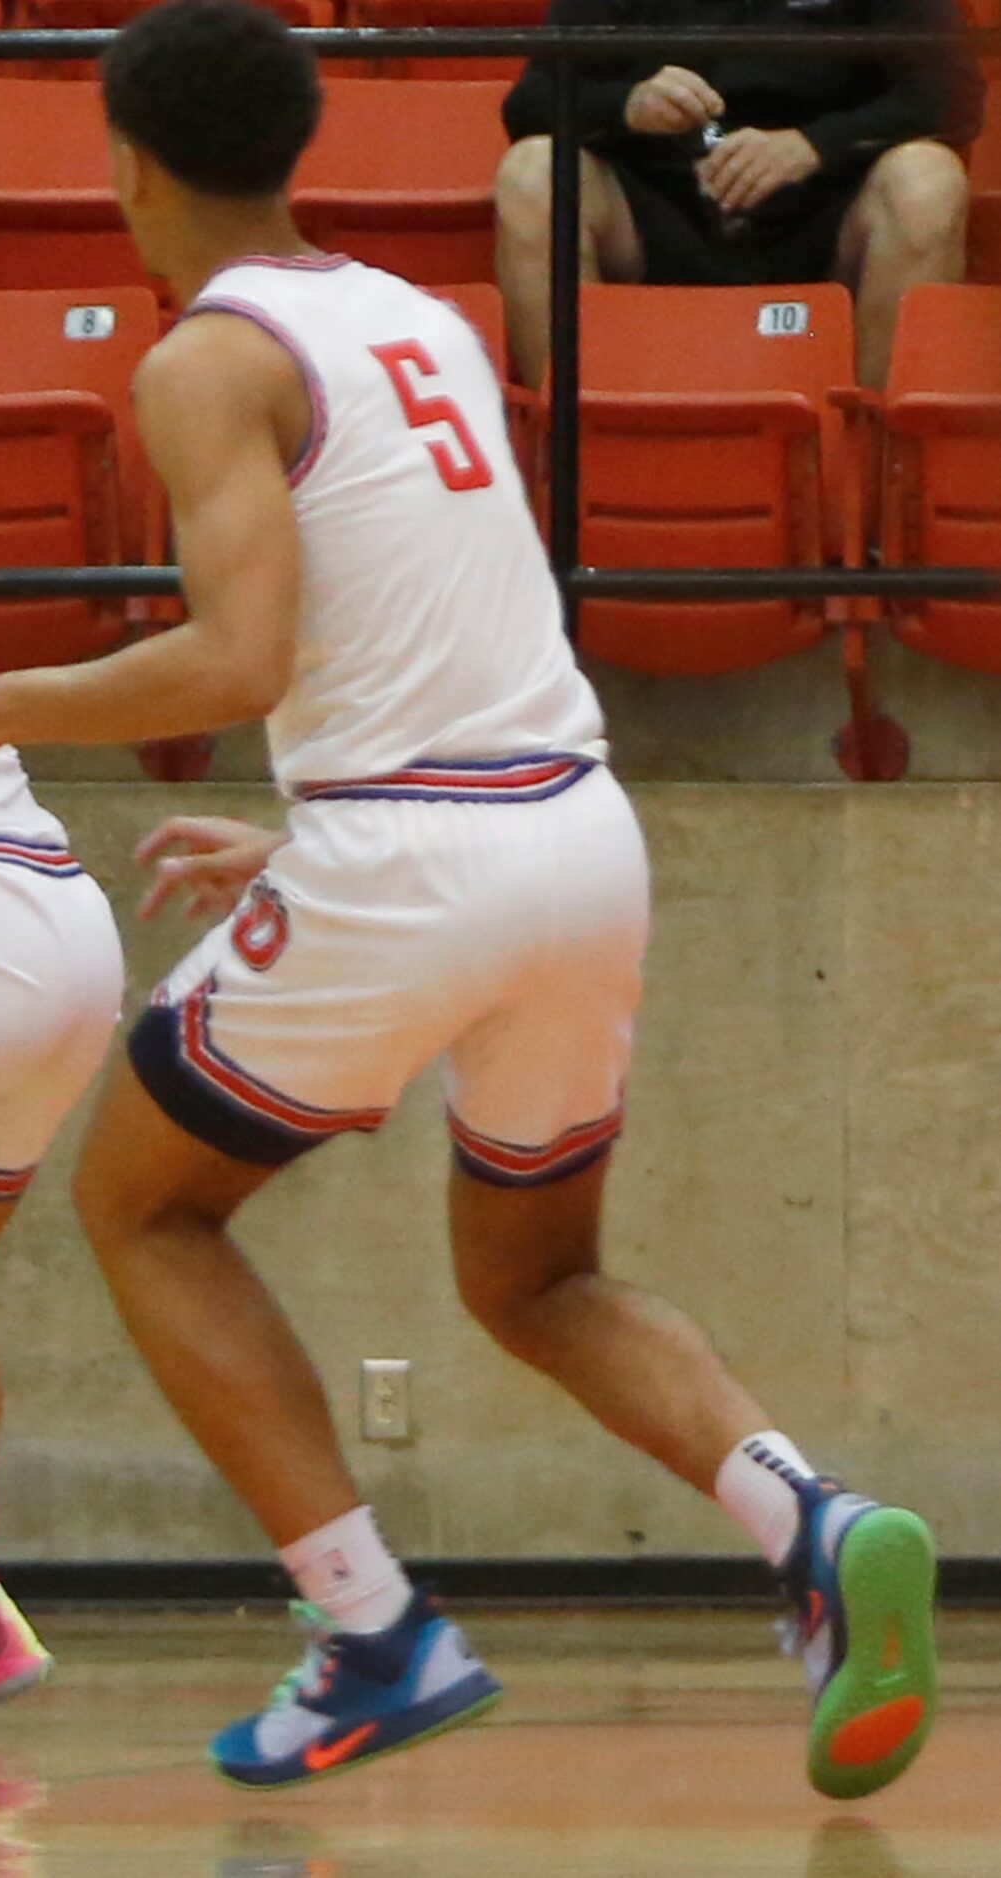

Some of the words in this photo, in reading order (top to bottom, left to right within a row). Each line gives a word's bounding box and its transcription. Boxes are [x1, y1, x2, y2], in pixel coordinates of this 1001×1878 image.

[82, 308, 97, 334] 8
[771, 305, 797, 331] 10
[366, 338, 494, 492] 5
